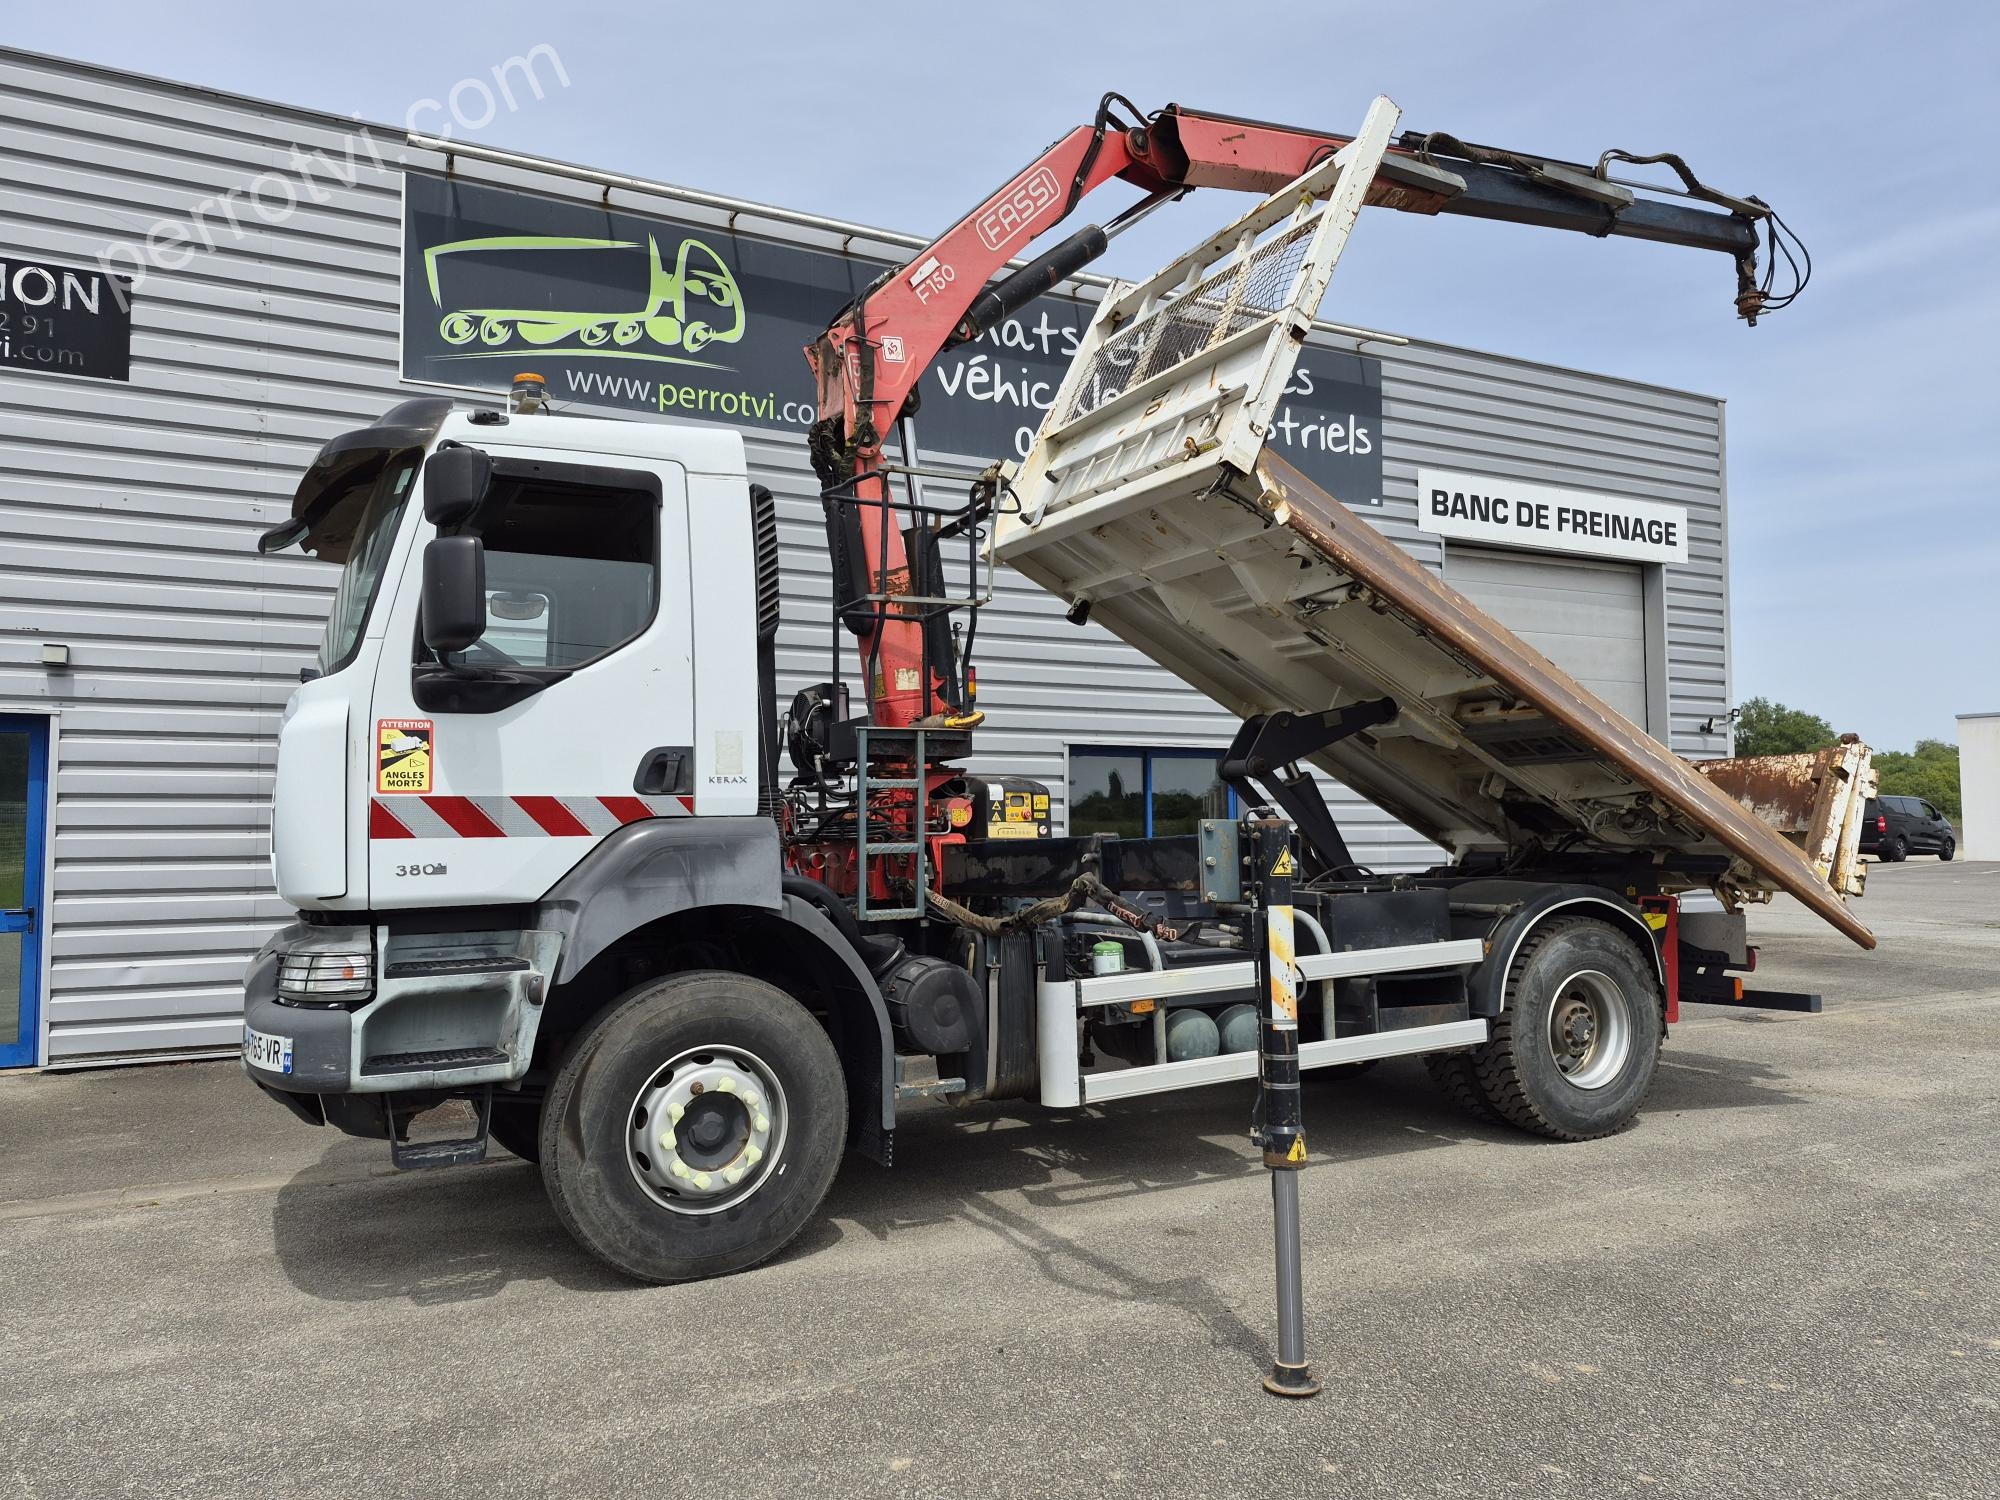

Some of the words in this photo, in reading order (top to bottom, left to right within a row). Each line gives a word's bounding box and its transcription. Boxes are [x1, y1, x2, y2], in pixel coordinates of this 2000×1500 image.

[982, 173, 1055, 244] FASSI
[915, 264, 956, 305] F150
[0, 335, 85, 367] i.com
[887, 342, 899, 357] 45
[565, 369, 819, 425] www.perrotvi.co
[1431, 489, 1509, 525] BANC
[1516, 501, 1550, 530] DE
[1557, 506, 1678, 547] FREINAGE
[381, 721, 431, 729] ATTENTION
[385, 771, 425, 779] ANGLES
[387, 779, 423, 787] MORTS
[708, 776, 748, 784] KERAX
